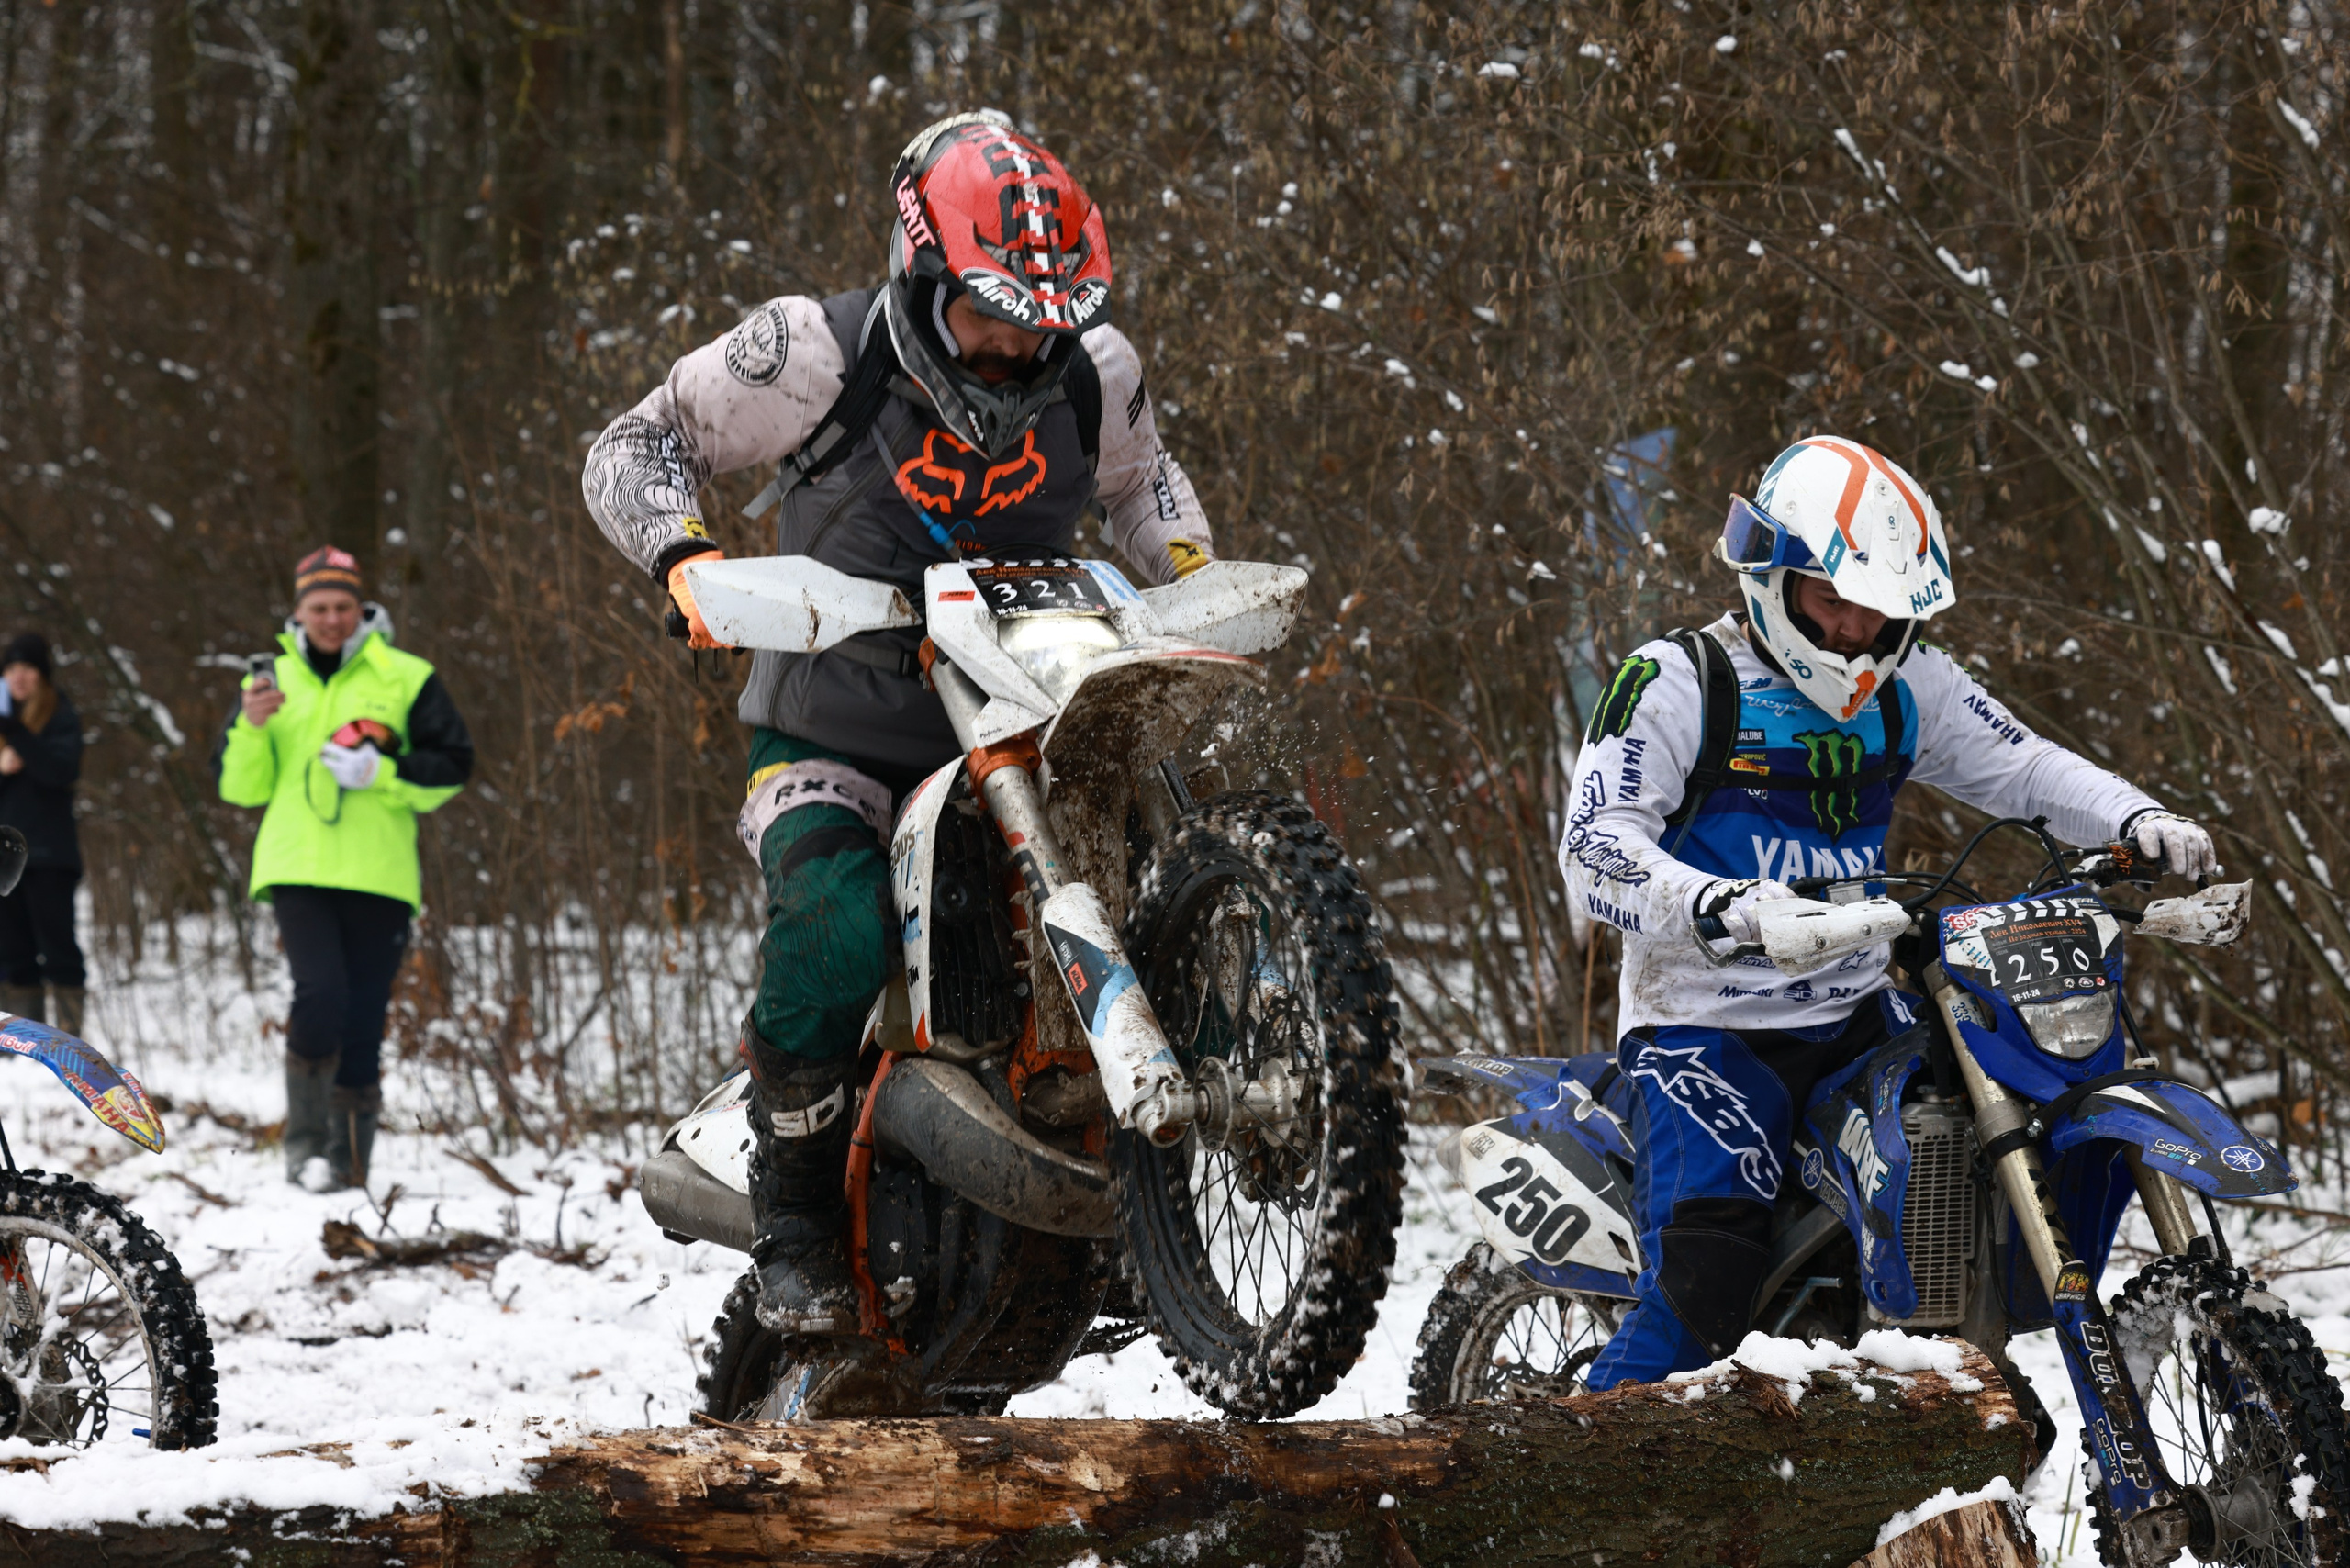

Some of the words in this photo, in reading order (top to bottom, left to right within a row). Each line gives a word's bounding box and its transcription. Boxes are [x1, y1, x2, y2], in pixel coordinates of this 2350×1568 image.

[967, 274, 1031, 322] Airoh
[1070, 282, 1108, 326] Airoh
[1909, 578, 1943, 615] HJC
[1617, 737, 1647, 803] YAMAHA
[1587, 893, 1644, 935] YAMAHA
[1990, 928, 2009, 940] Лев
[2011, 988, 2042, 1003] 16-11-24
[1837, 1107, 1890, 1205] WRF
[2154, 1137, 2202, 1161] GoPro
[1475, 1157, 1592, 1265] 250
[2096, 1417, 2122, 1484] GoPro
